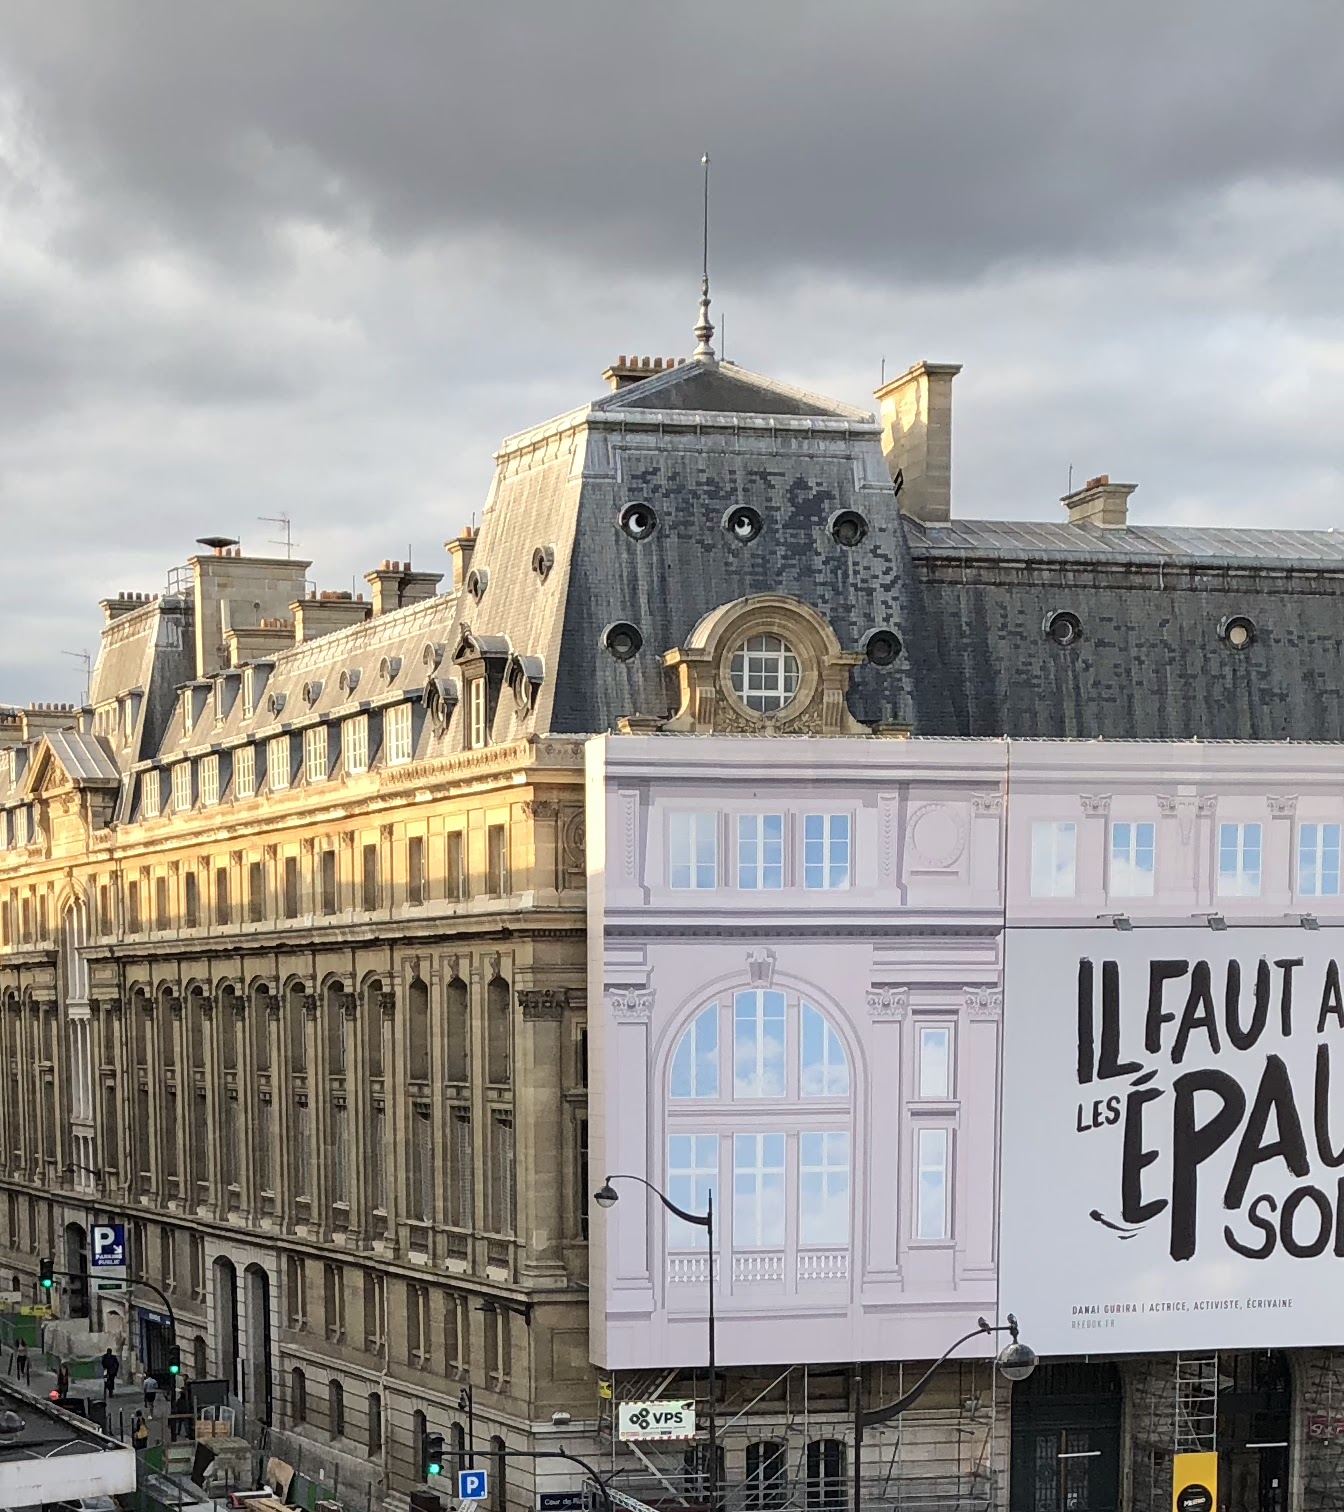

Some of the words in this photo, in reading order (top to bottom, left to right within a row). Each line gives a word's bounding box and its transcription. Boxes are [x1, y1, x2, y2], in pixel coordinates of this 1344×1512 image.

[1077, 957, 1144, 1084] IL
[1144, 957, 1304, 1064] FAUT
[1076, 1096, 1121, 1132] LES
[94, 1226, 116, 1254] P
[1072, 1304, 1100, 1315] DANAI
[1103, 1304, 1137, 1314] GURIRA
[1149, 1301, 1190, 1312] ACTRICE,
[1193, 1300, 1243, 1311] ACTIVISTE,
[1246, 1297, 1293, 1309] ÉCRIVAINE
[652, 1411, 683, 1424] VPS
[466, 1476, 480, 1495] P
